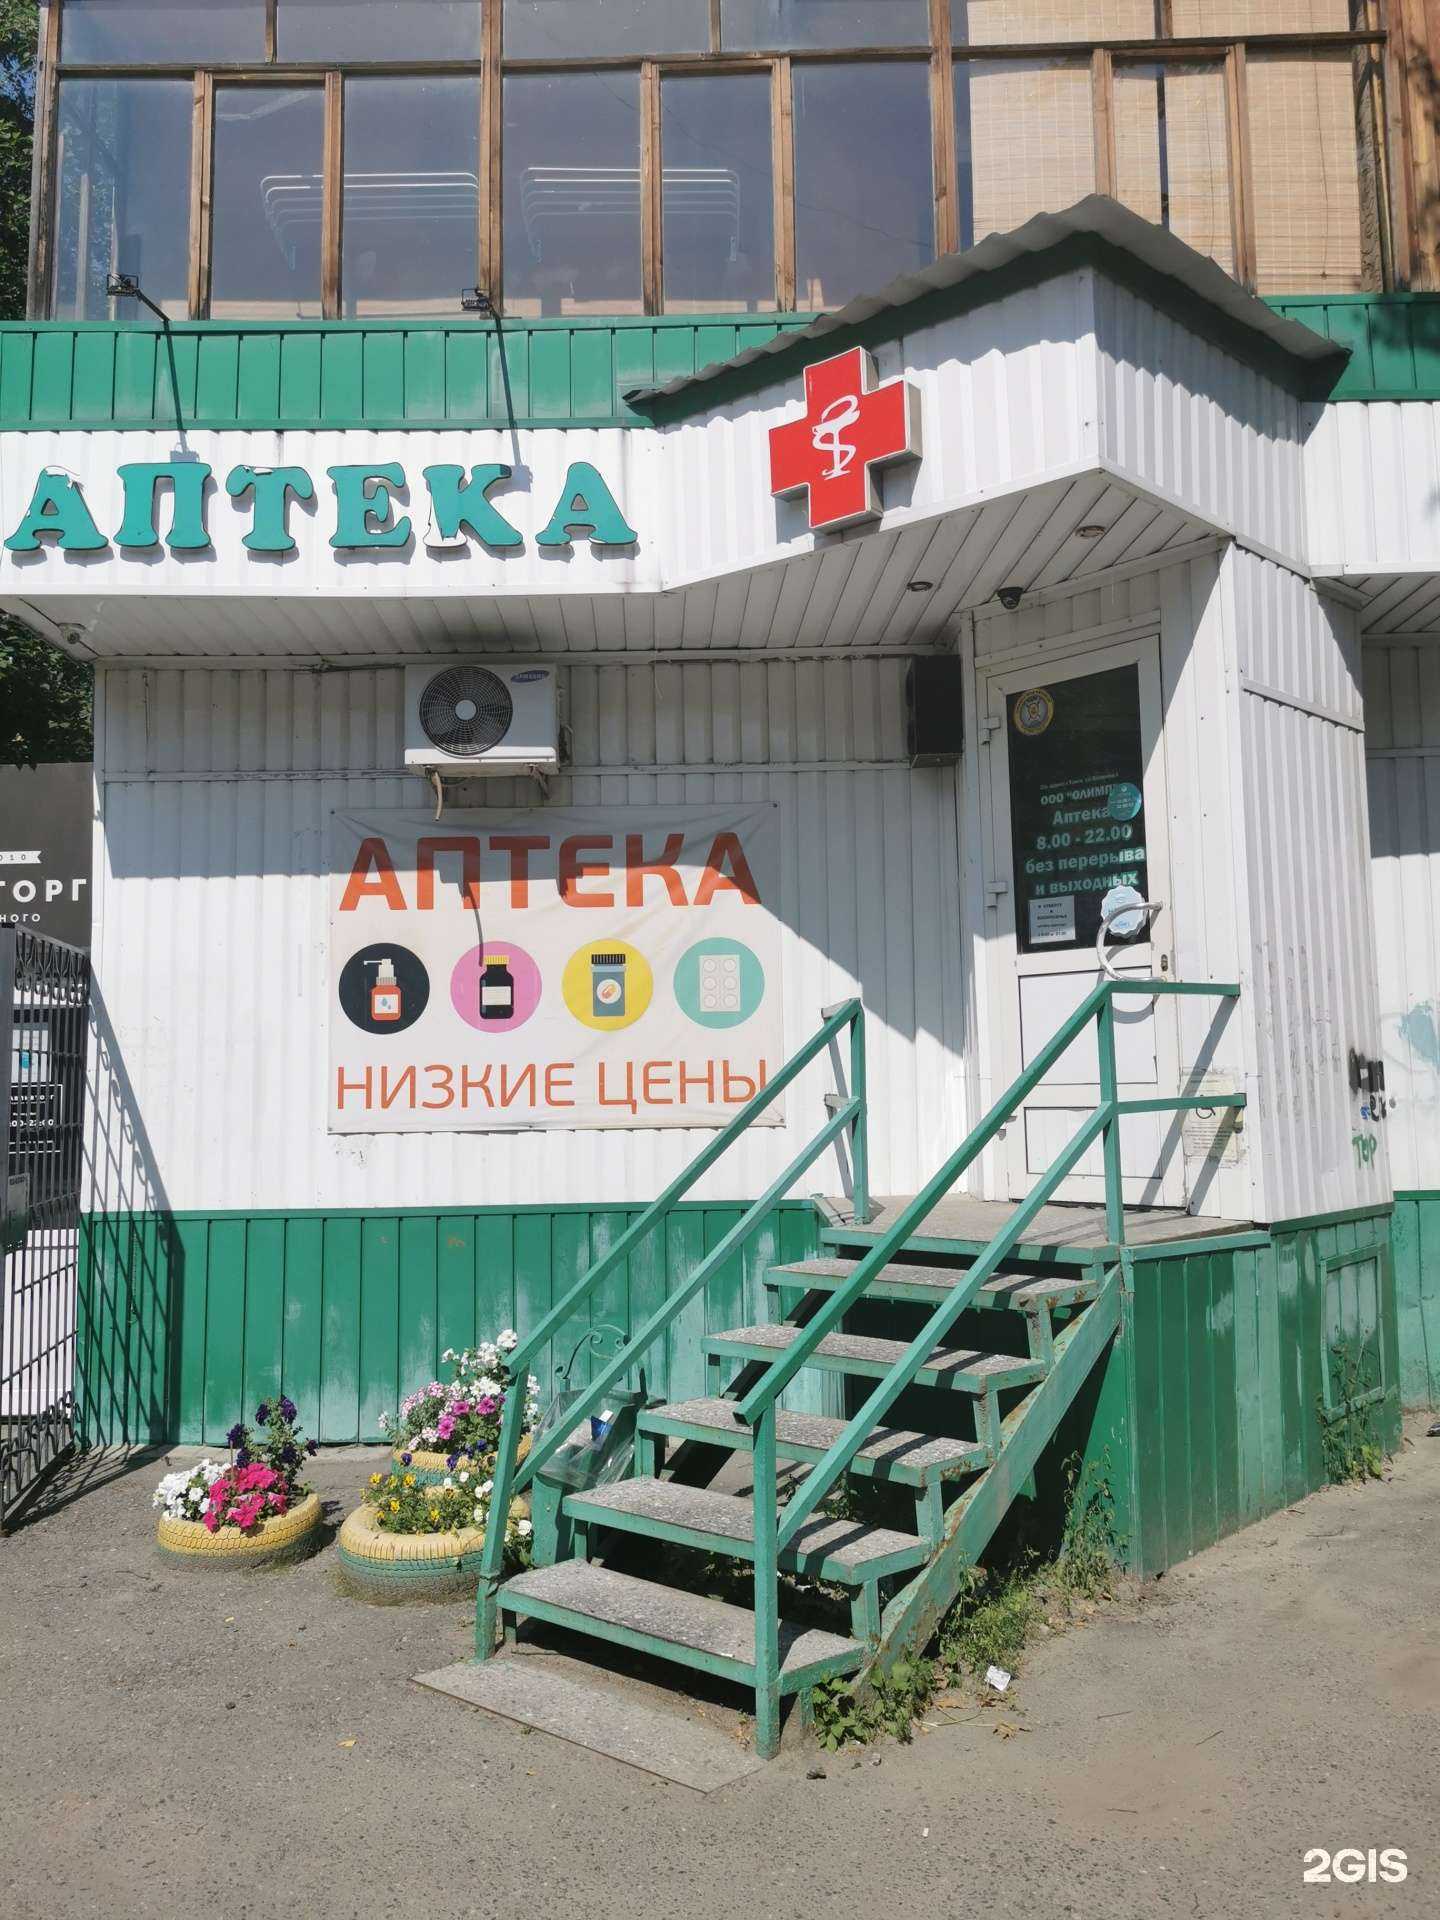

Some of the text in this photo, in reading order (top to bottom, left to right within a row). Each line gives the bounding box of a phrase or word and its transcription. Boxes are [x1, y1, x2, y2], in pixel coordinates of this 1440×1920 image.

[4, 461, 639, 551] АПТЕКА
[1053, 807, 1110, 826] Аптека
[1037, 833, 1071, 850] 8.00
[1084, 824, 1133, 844] 22.00
[339, 832, 763, 911] АПТЕКА
[1025, 847, 1145, 873] без перерыва
[1035, 870, 1139, 896] и выходных
[337, 1059, 767, 1115] НИЗКИЕ ЦЕНЫ
